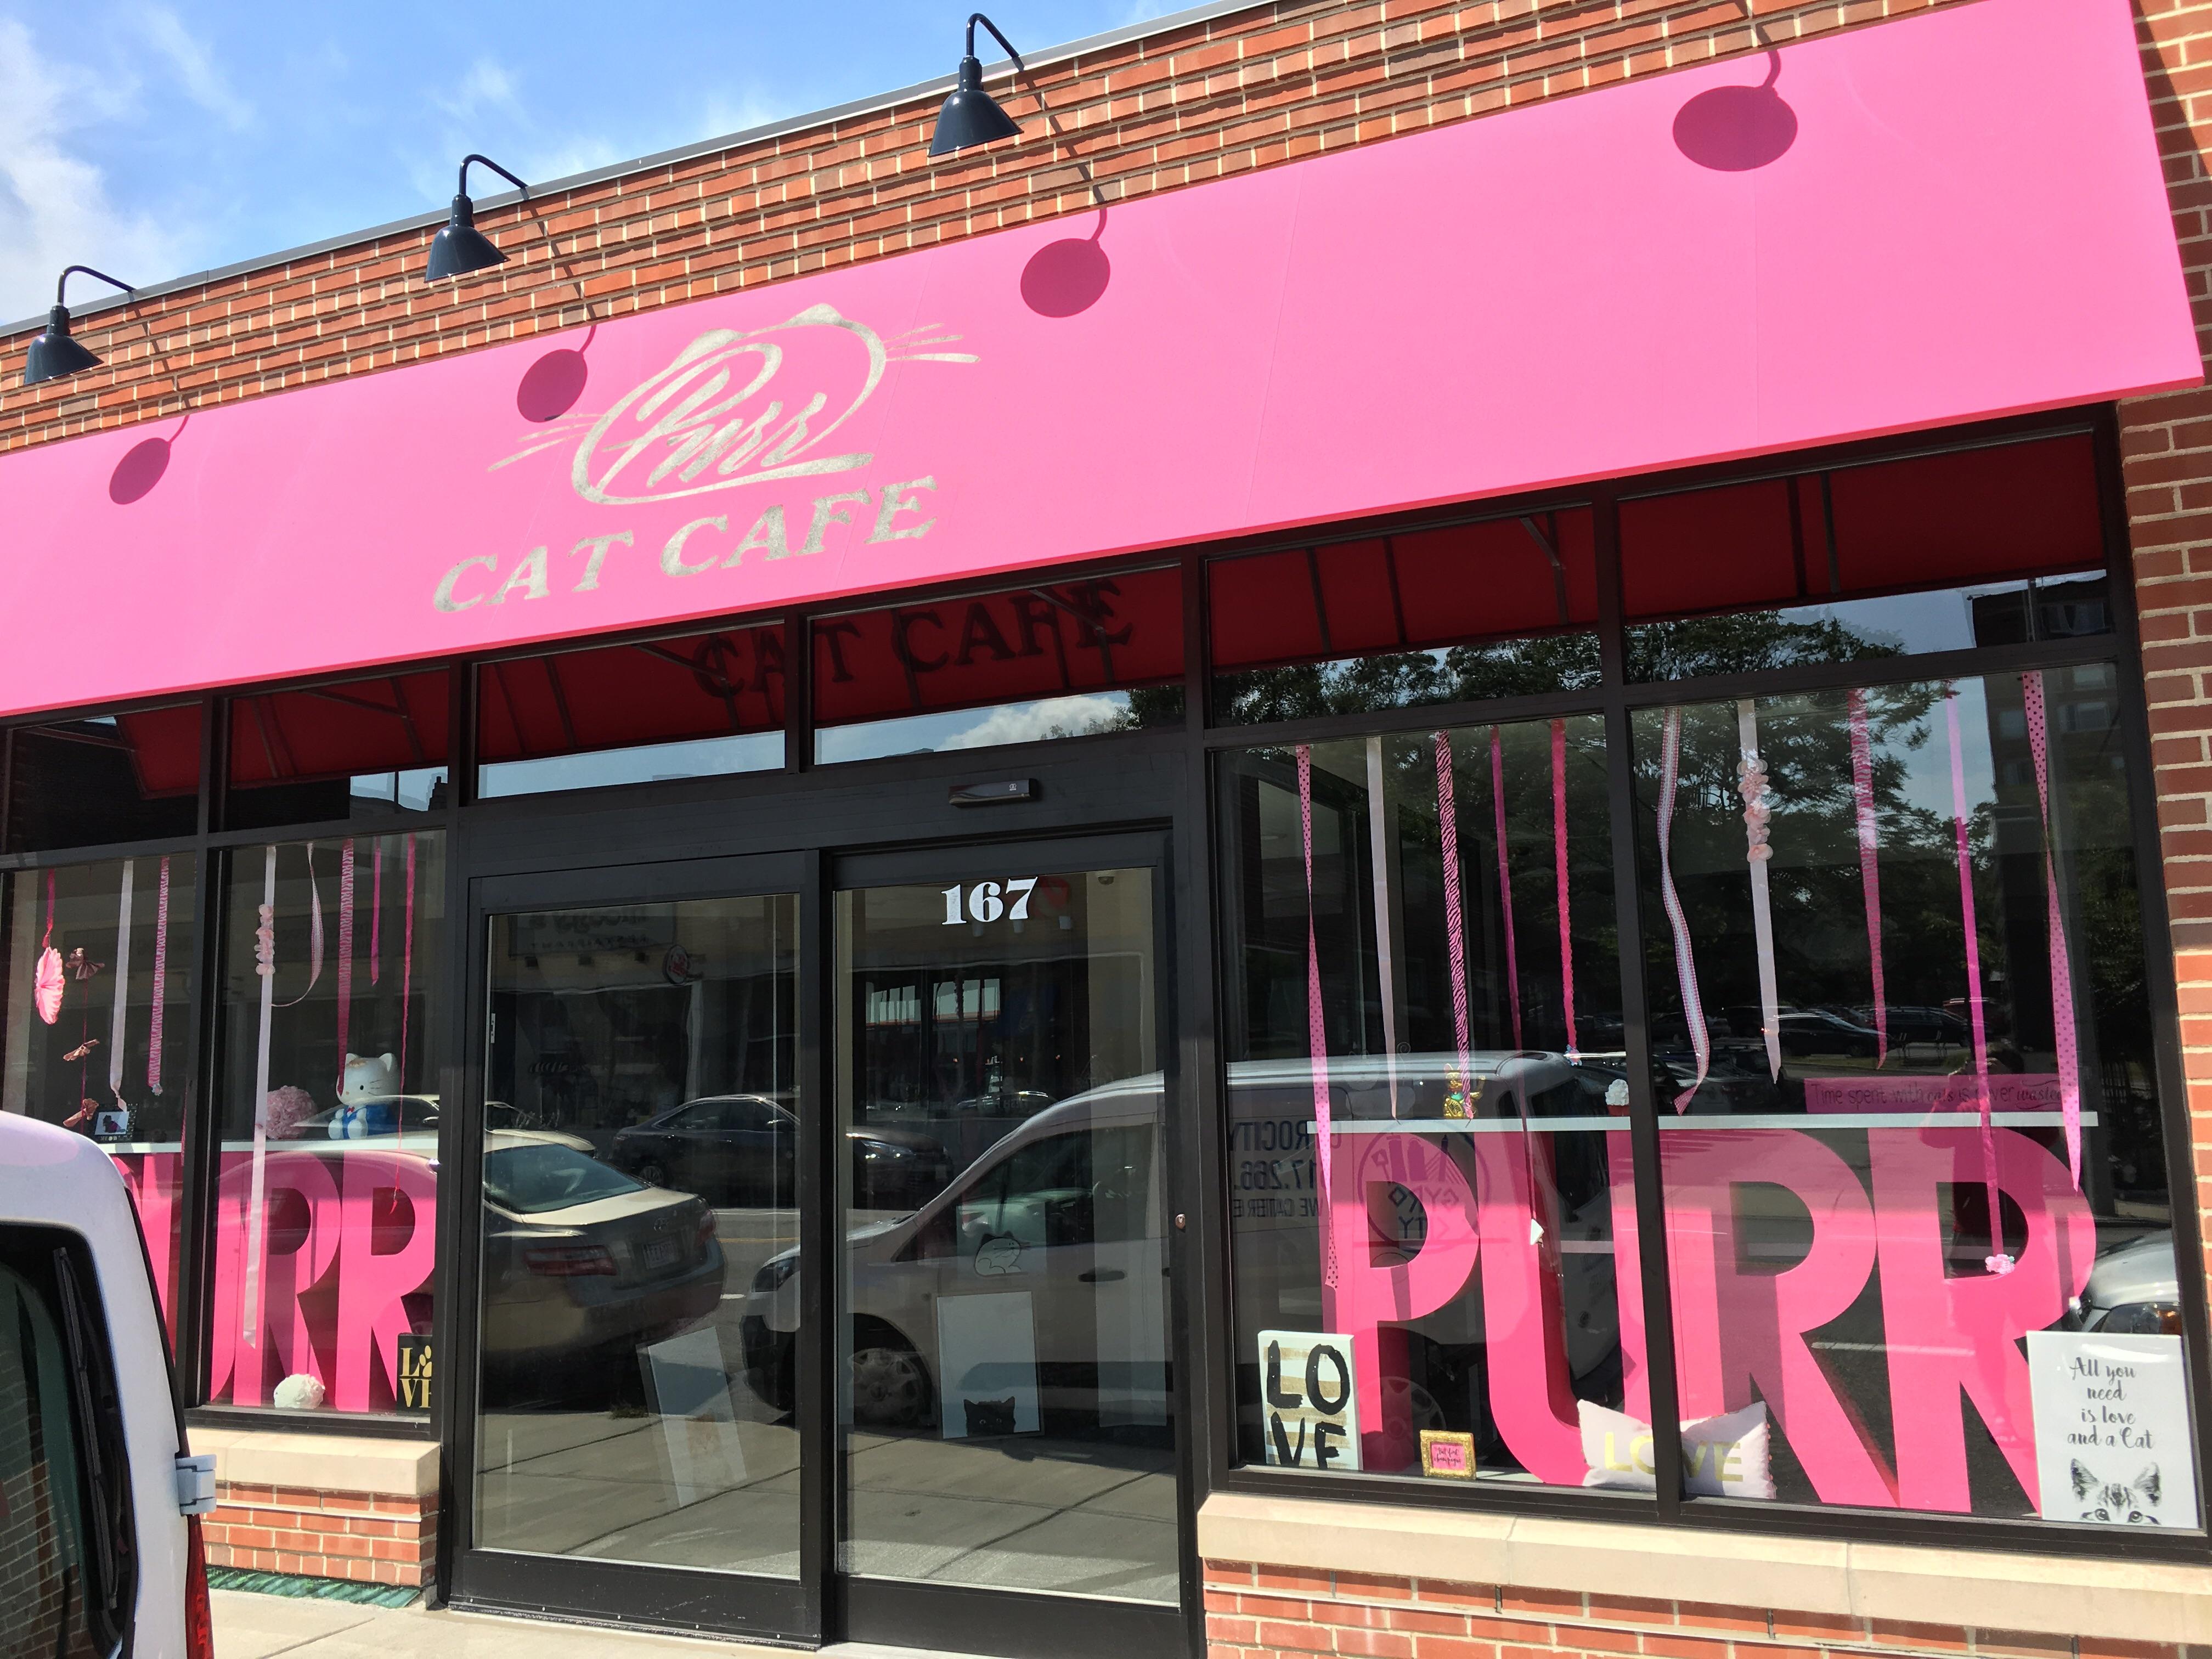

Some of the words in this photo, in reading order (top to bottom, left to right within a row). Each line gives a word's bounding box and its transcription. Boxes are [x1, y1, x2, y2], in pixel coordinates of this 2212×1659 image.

[595, 341, 827, 494] Purr
[433, 530, 634, 613] CAT
[660, 475, 938, 577] CAFE
[692, 620, 861, 699] CAT
[893, 579, 1134, 673] CAFE
[941, 877, 1038, 925] 167
[1812, 1084, 1843, 1104] Time
[1847, 1086, 1887, 1110] spent
[1892, 1081, 1924, 1104] with
[1975, 1086, 2015, 1102] ver
[1321, 1128, 2097, 1518] PURR
[2069, 1357, 2099, 1380] All
[2106, 1364, 2137, 1385] you
[2087, 1380, 2127, 1401] need
[2081, 1408, 2097, 1423] is
[2102, 1406, 2137, 1425] love
[2067, 1425, 2102, 1447] and
[2106, 1435, 2117, 1447] a
[2120, 1426, 2155, 1449] Cat
